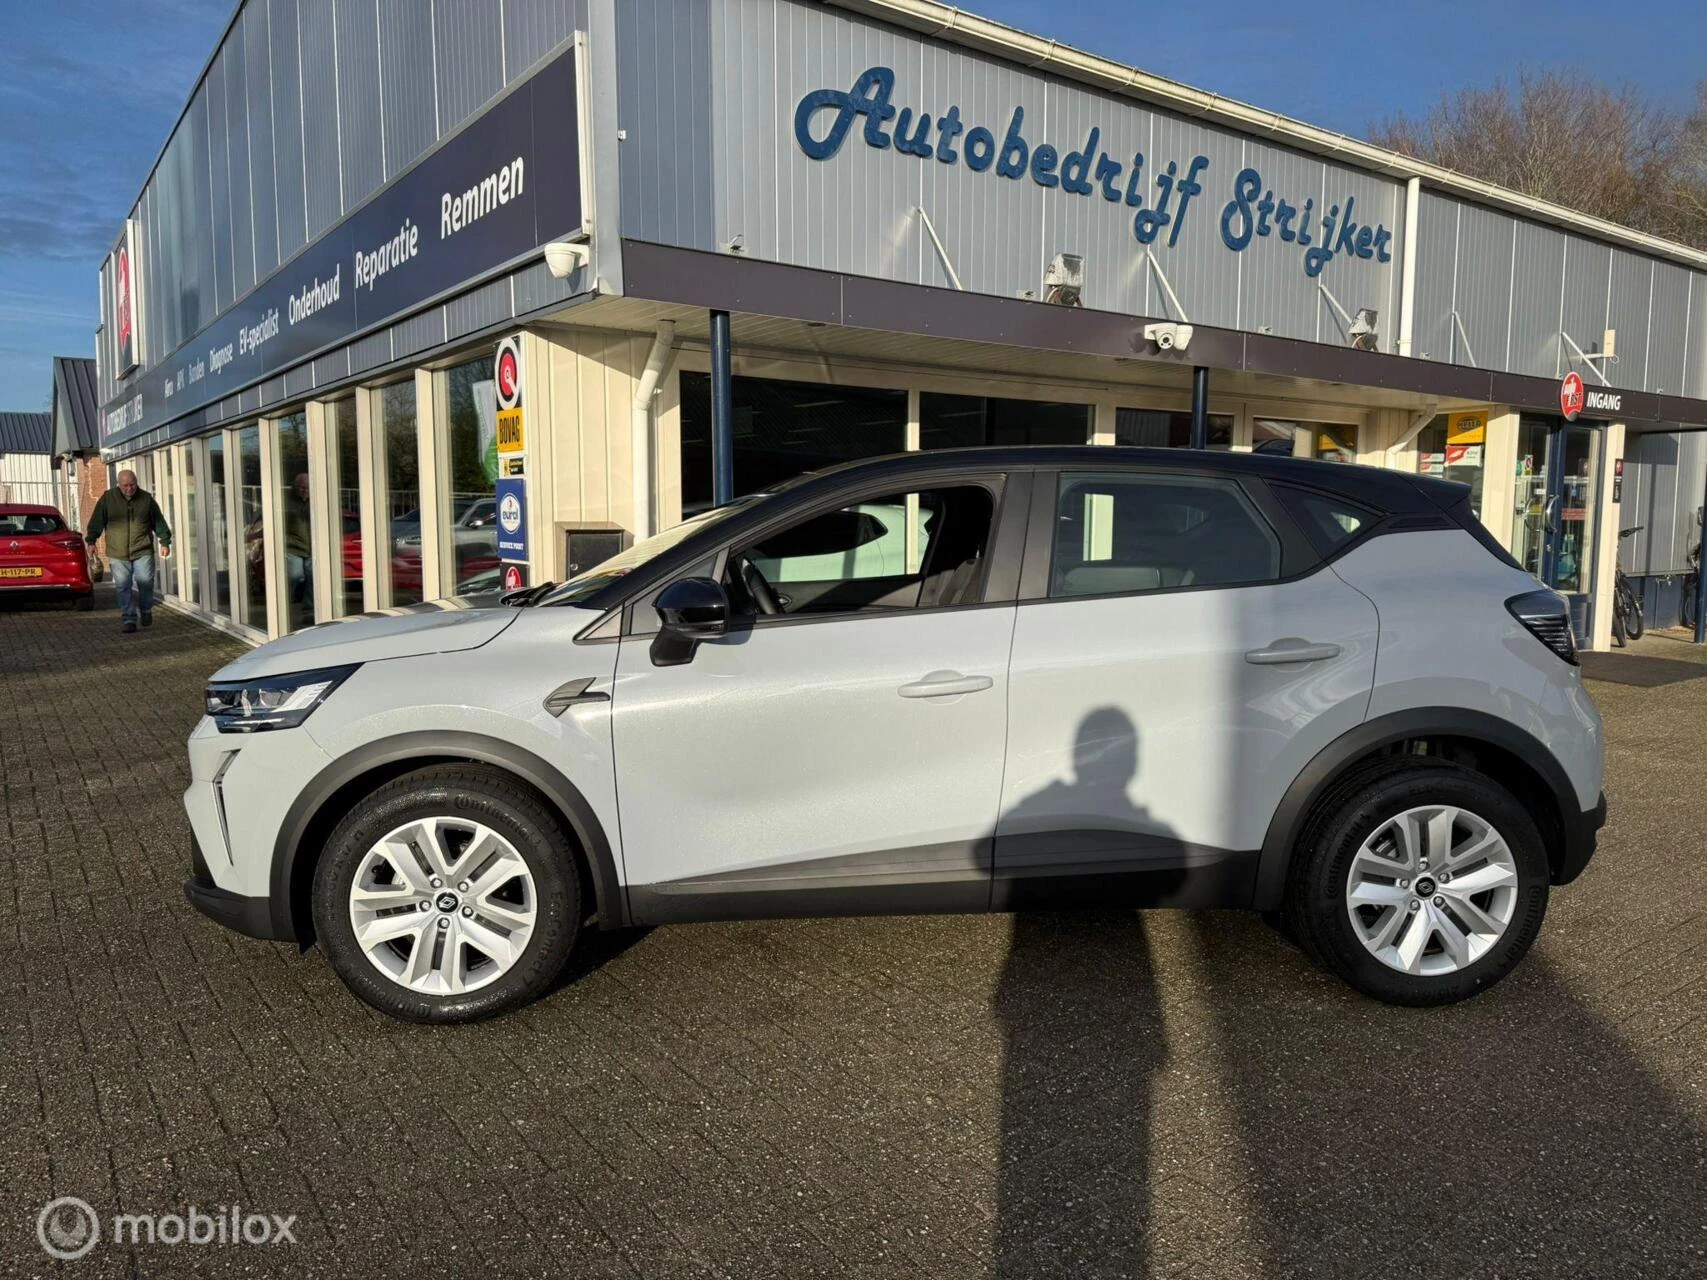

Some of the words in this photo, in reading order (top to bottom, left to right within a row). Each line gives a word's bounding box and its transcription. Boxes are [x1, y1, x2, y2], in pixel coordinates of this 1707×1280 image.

[794, 66, 1209, 247] Autobedrijf
[1221, 167, 1392, 278] Strijker
[209, 342, 233, 374] Diagnose
[239, 307, 280, 356] EV-specialist
[287, 263, 340, 326] Onderhoud
[355, 217, 418, 292] Reparatie
[440, 155, 524, 240] Remmen
[499, 416, 520, 444] BOVAG
[1586, 391, 1621, 410] INGANG
